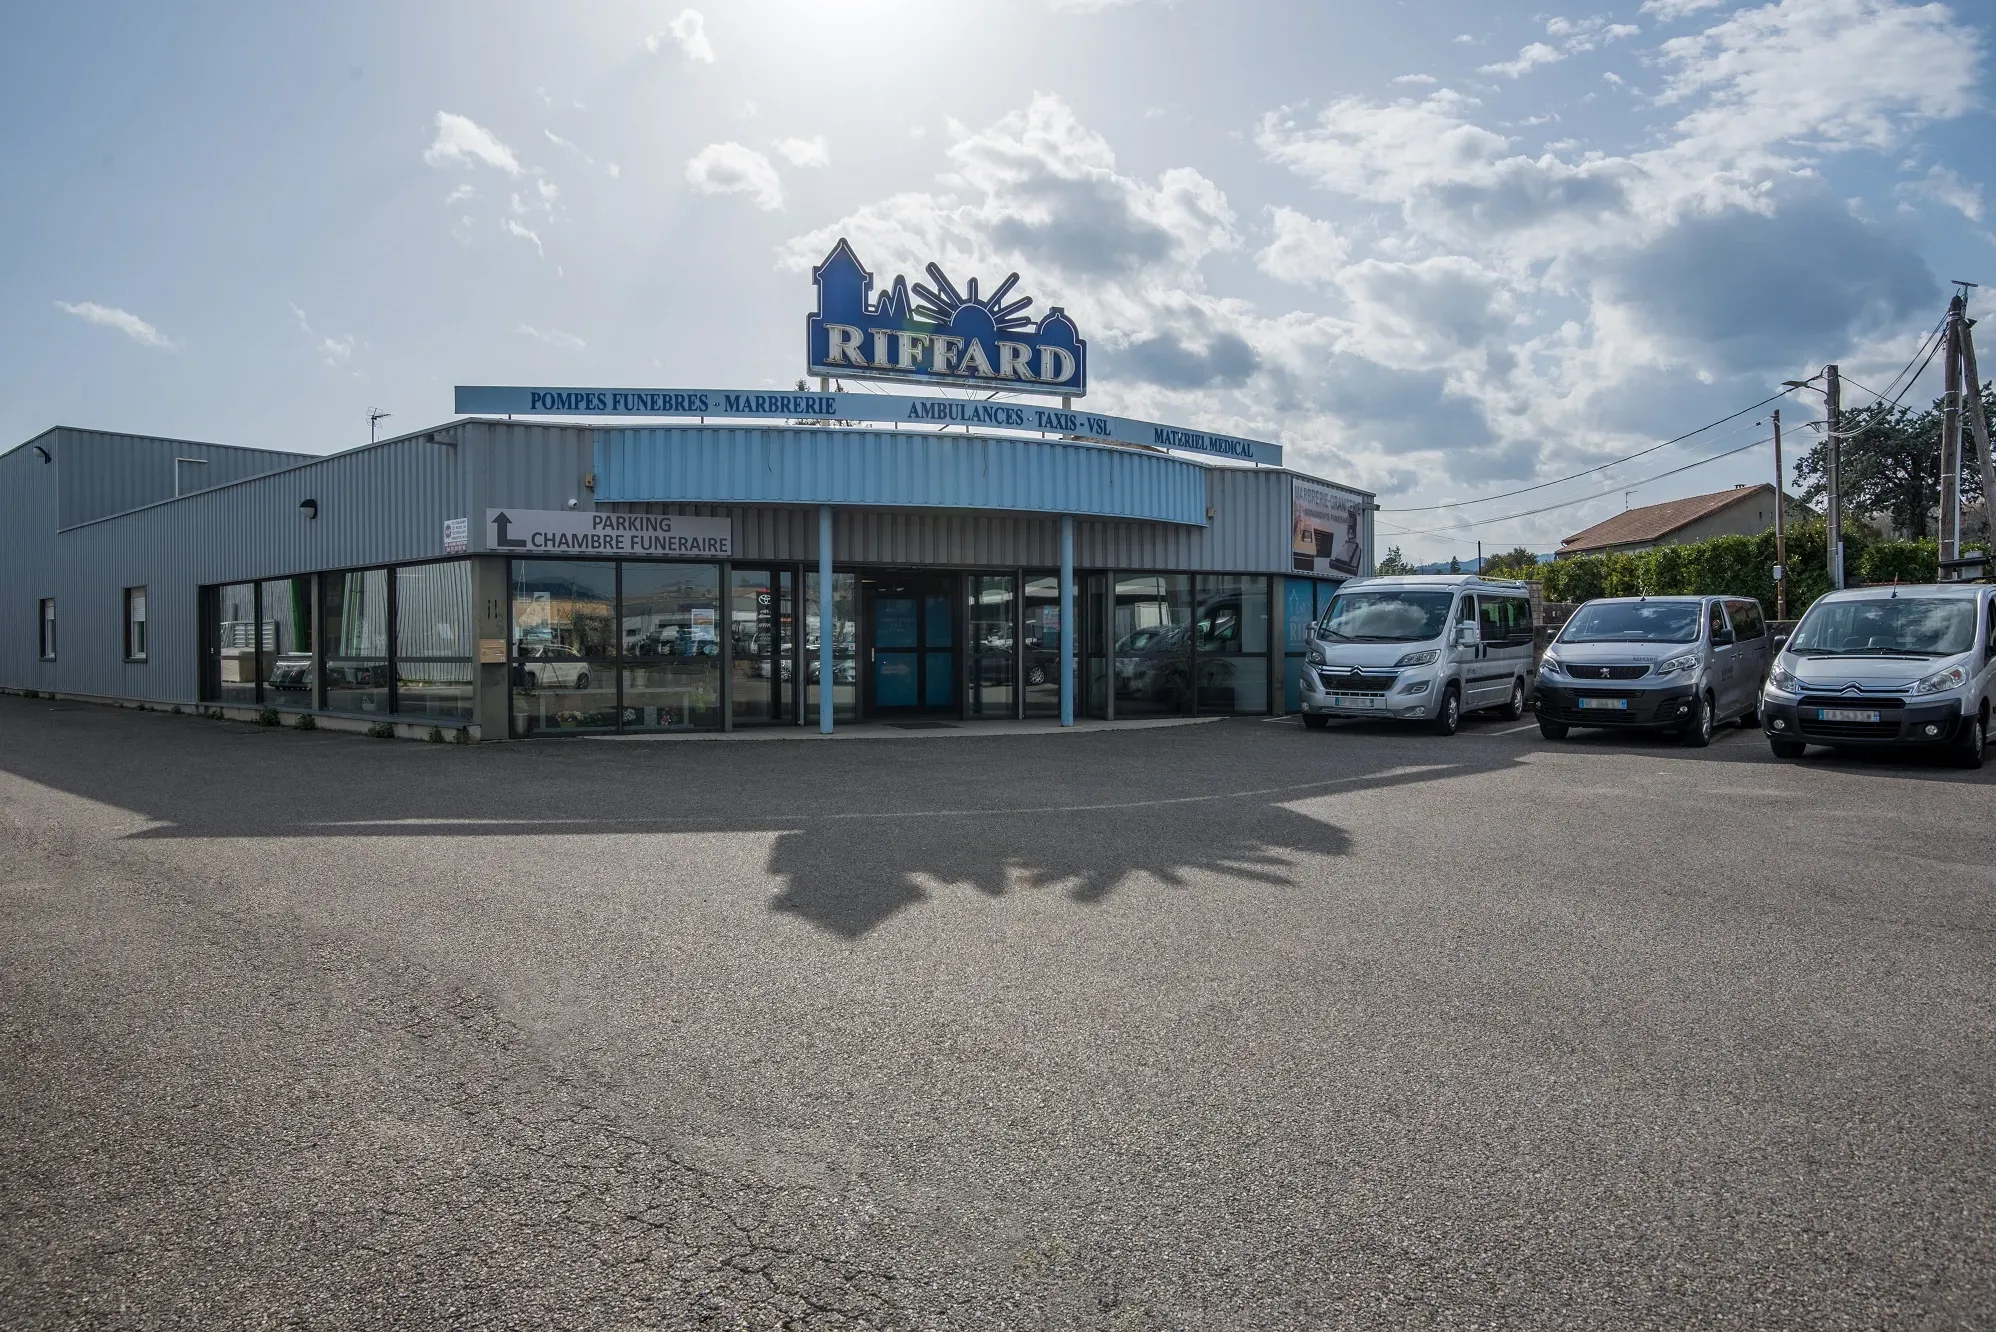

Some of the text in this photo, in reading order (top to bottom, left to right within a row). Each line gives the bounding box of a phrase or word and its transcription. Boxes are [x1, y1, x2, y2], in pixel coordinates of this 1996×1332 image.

[823, 323, 1076, 384] RIFFARD
[530, 391, 607, 411] POMPES
[611, 393, 709, 413] FUNEBRES
[724, 394, 837, 415] MARBRERIE
[908, 400, 1024, 426] AMBULANCES
[1035, 410, 1078, 432] TAXIS
[1087, 416, 1112, 436] VSL
[1154, 427, 1254, 458] MATERIEL MEDICAL
[592, 515, 672, 533] PARKING
[531, 532, 728, 553] CHAMBRE FUNERAIRE
